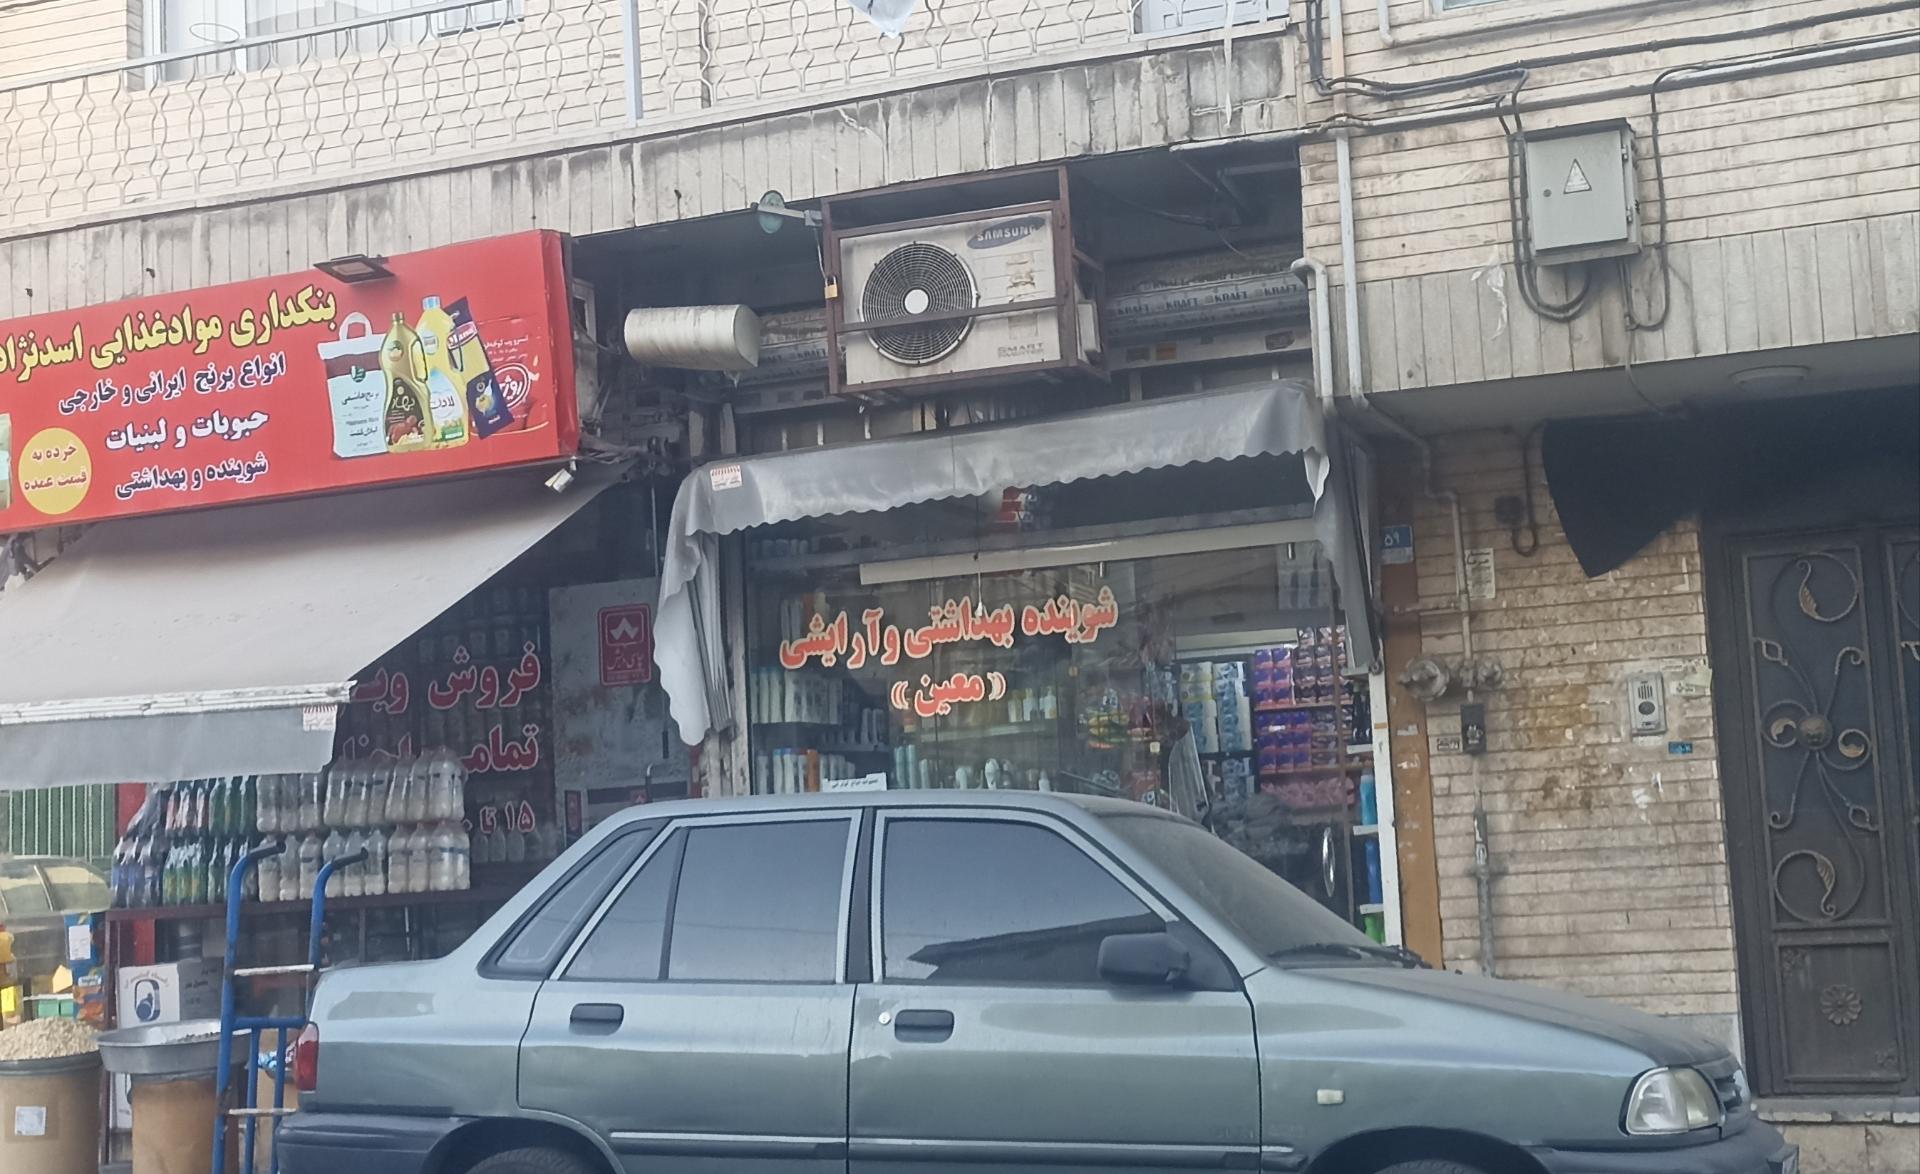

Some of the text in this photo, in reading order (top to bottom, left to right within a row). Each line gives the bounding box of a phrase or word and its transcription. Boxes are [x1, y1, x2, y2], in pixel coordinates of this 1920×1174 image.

[977, 225, 1037, 242] SAMSUNG
[229, 285, 337, 347] بنکداری
[1166, 298, 1199, 310] KRAFT
[1215, 291, 1248, 303] KRAFT
[1264, 284, 1297, 296] KRAFT
[58, 352, 286, 414] انواع برنج ایرانی و خارجی
[105, 410, 270, 452] حبوبات و لبنیات
[115, 451, 268, 500] شوینده و بهداشتی
[779, 607, 884, 669] آرایشی
[904, 596, 1015, 658] بهداشتی
[1021, 585, 1119, 643] شوینده
[428, 641, 541, 709] فروش
[505, 801, 536, 833] ۱۵
